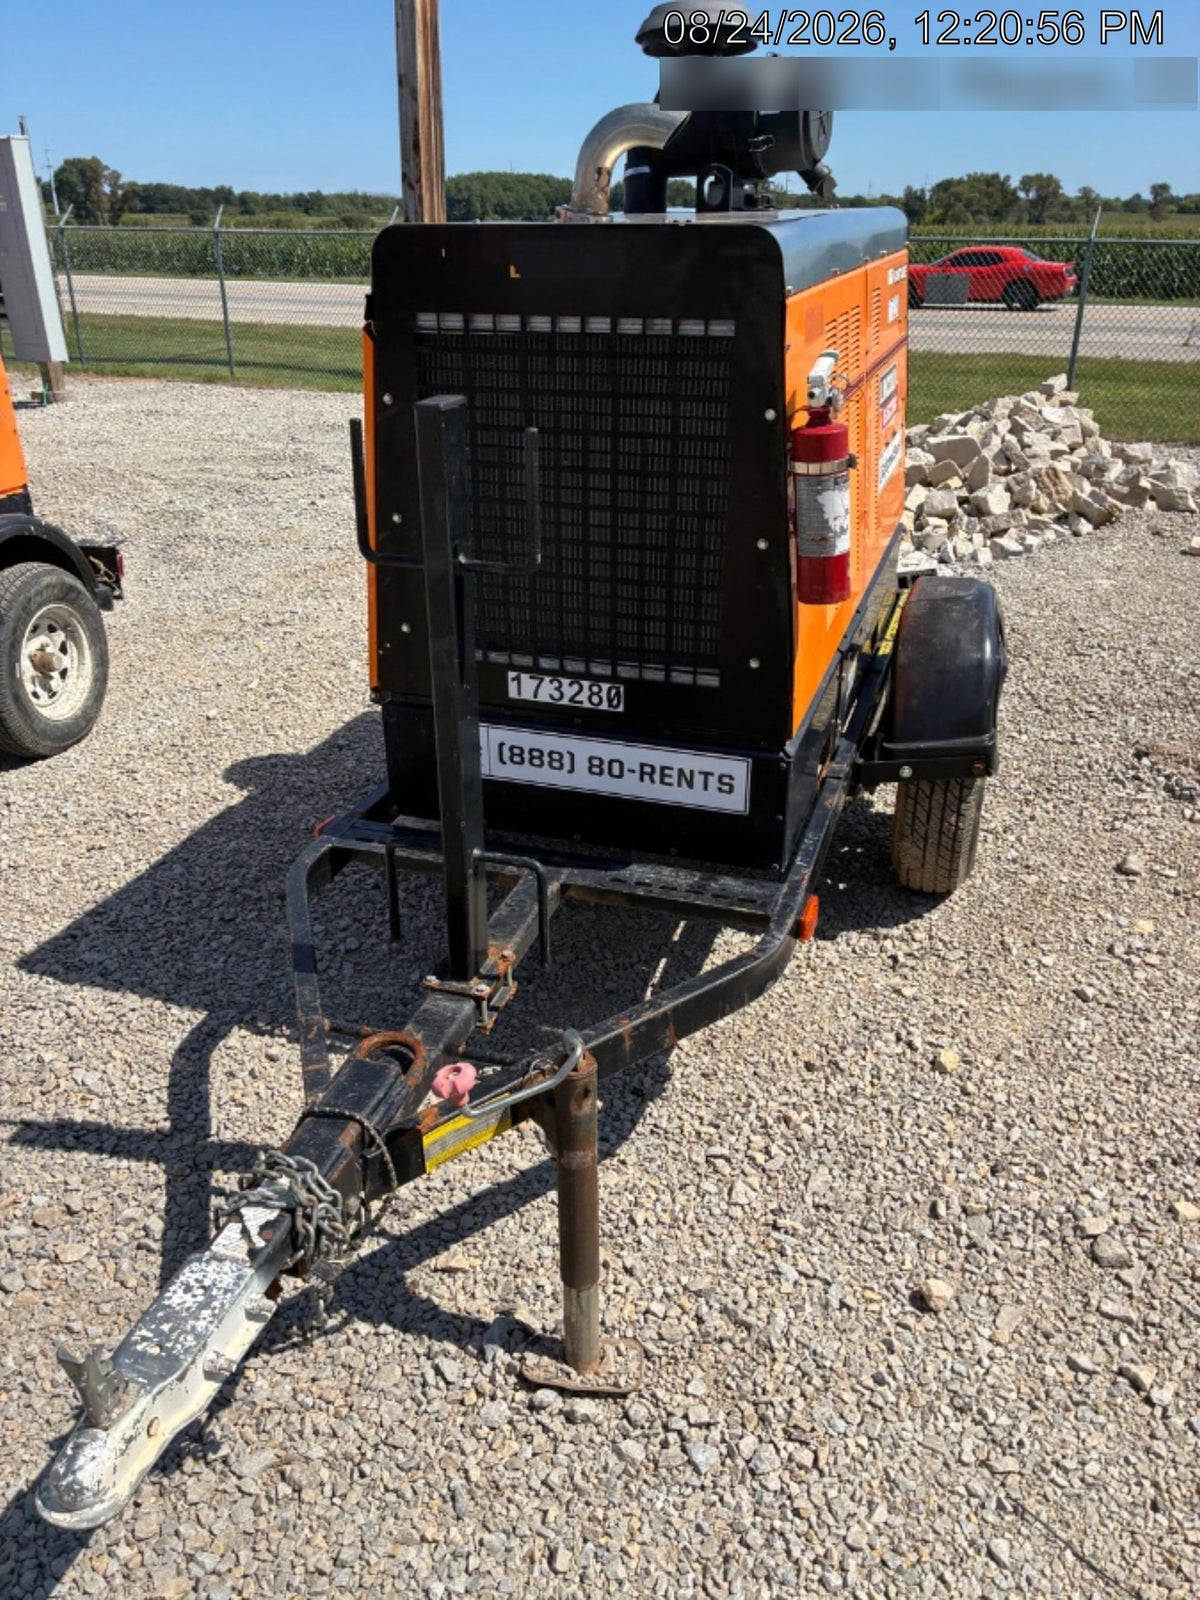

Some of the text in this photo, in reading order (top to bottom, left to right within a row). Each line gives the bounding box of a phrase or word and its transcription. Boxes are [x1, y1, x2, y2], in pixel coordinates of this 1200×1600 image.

[511, 673, 621, 709] 173280
[497, 741, 735, 795] (888) 80-RENTS
